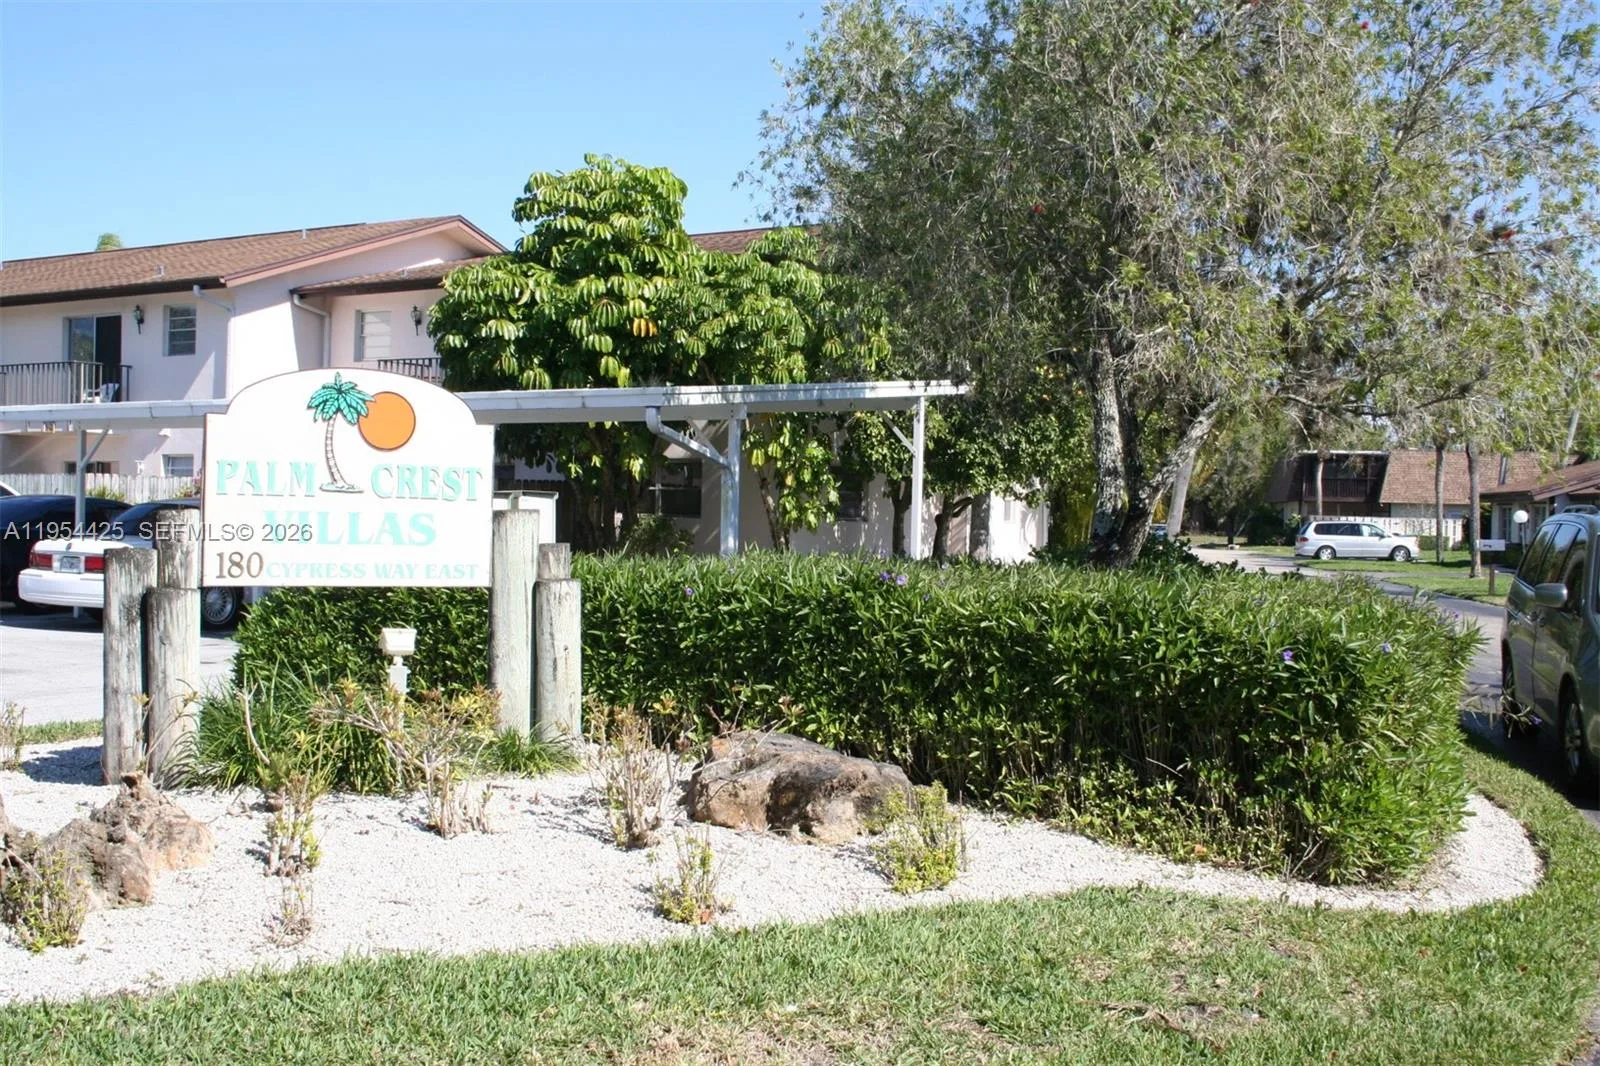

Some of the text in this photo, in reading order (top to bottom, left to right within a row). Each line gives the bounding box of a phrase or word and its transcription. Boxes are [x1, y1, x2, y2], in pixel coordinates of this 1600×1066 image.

[216, 459, 483, 501] PALM CREST
[263, 510, 437, 546] VILLAS
[215, 551, 479, 580] 180 CYPRESS WAY EAST
